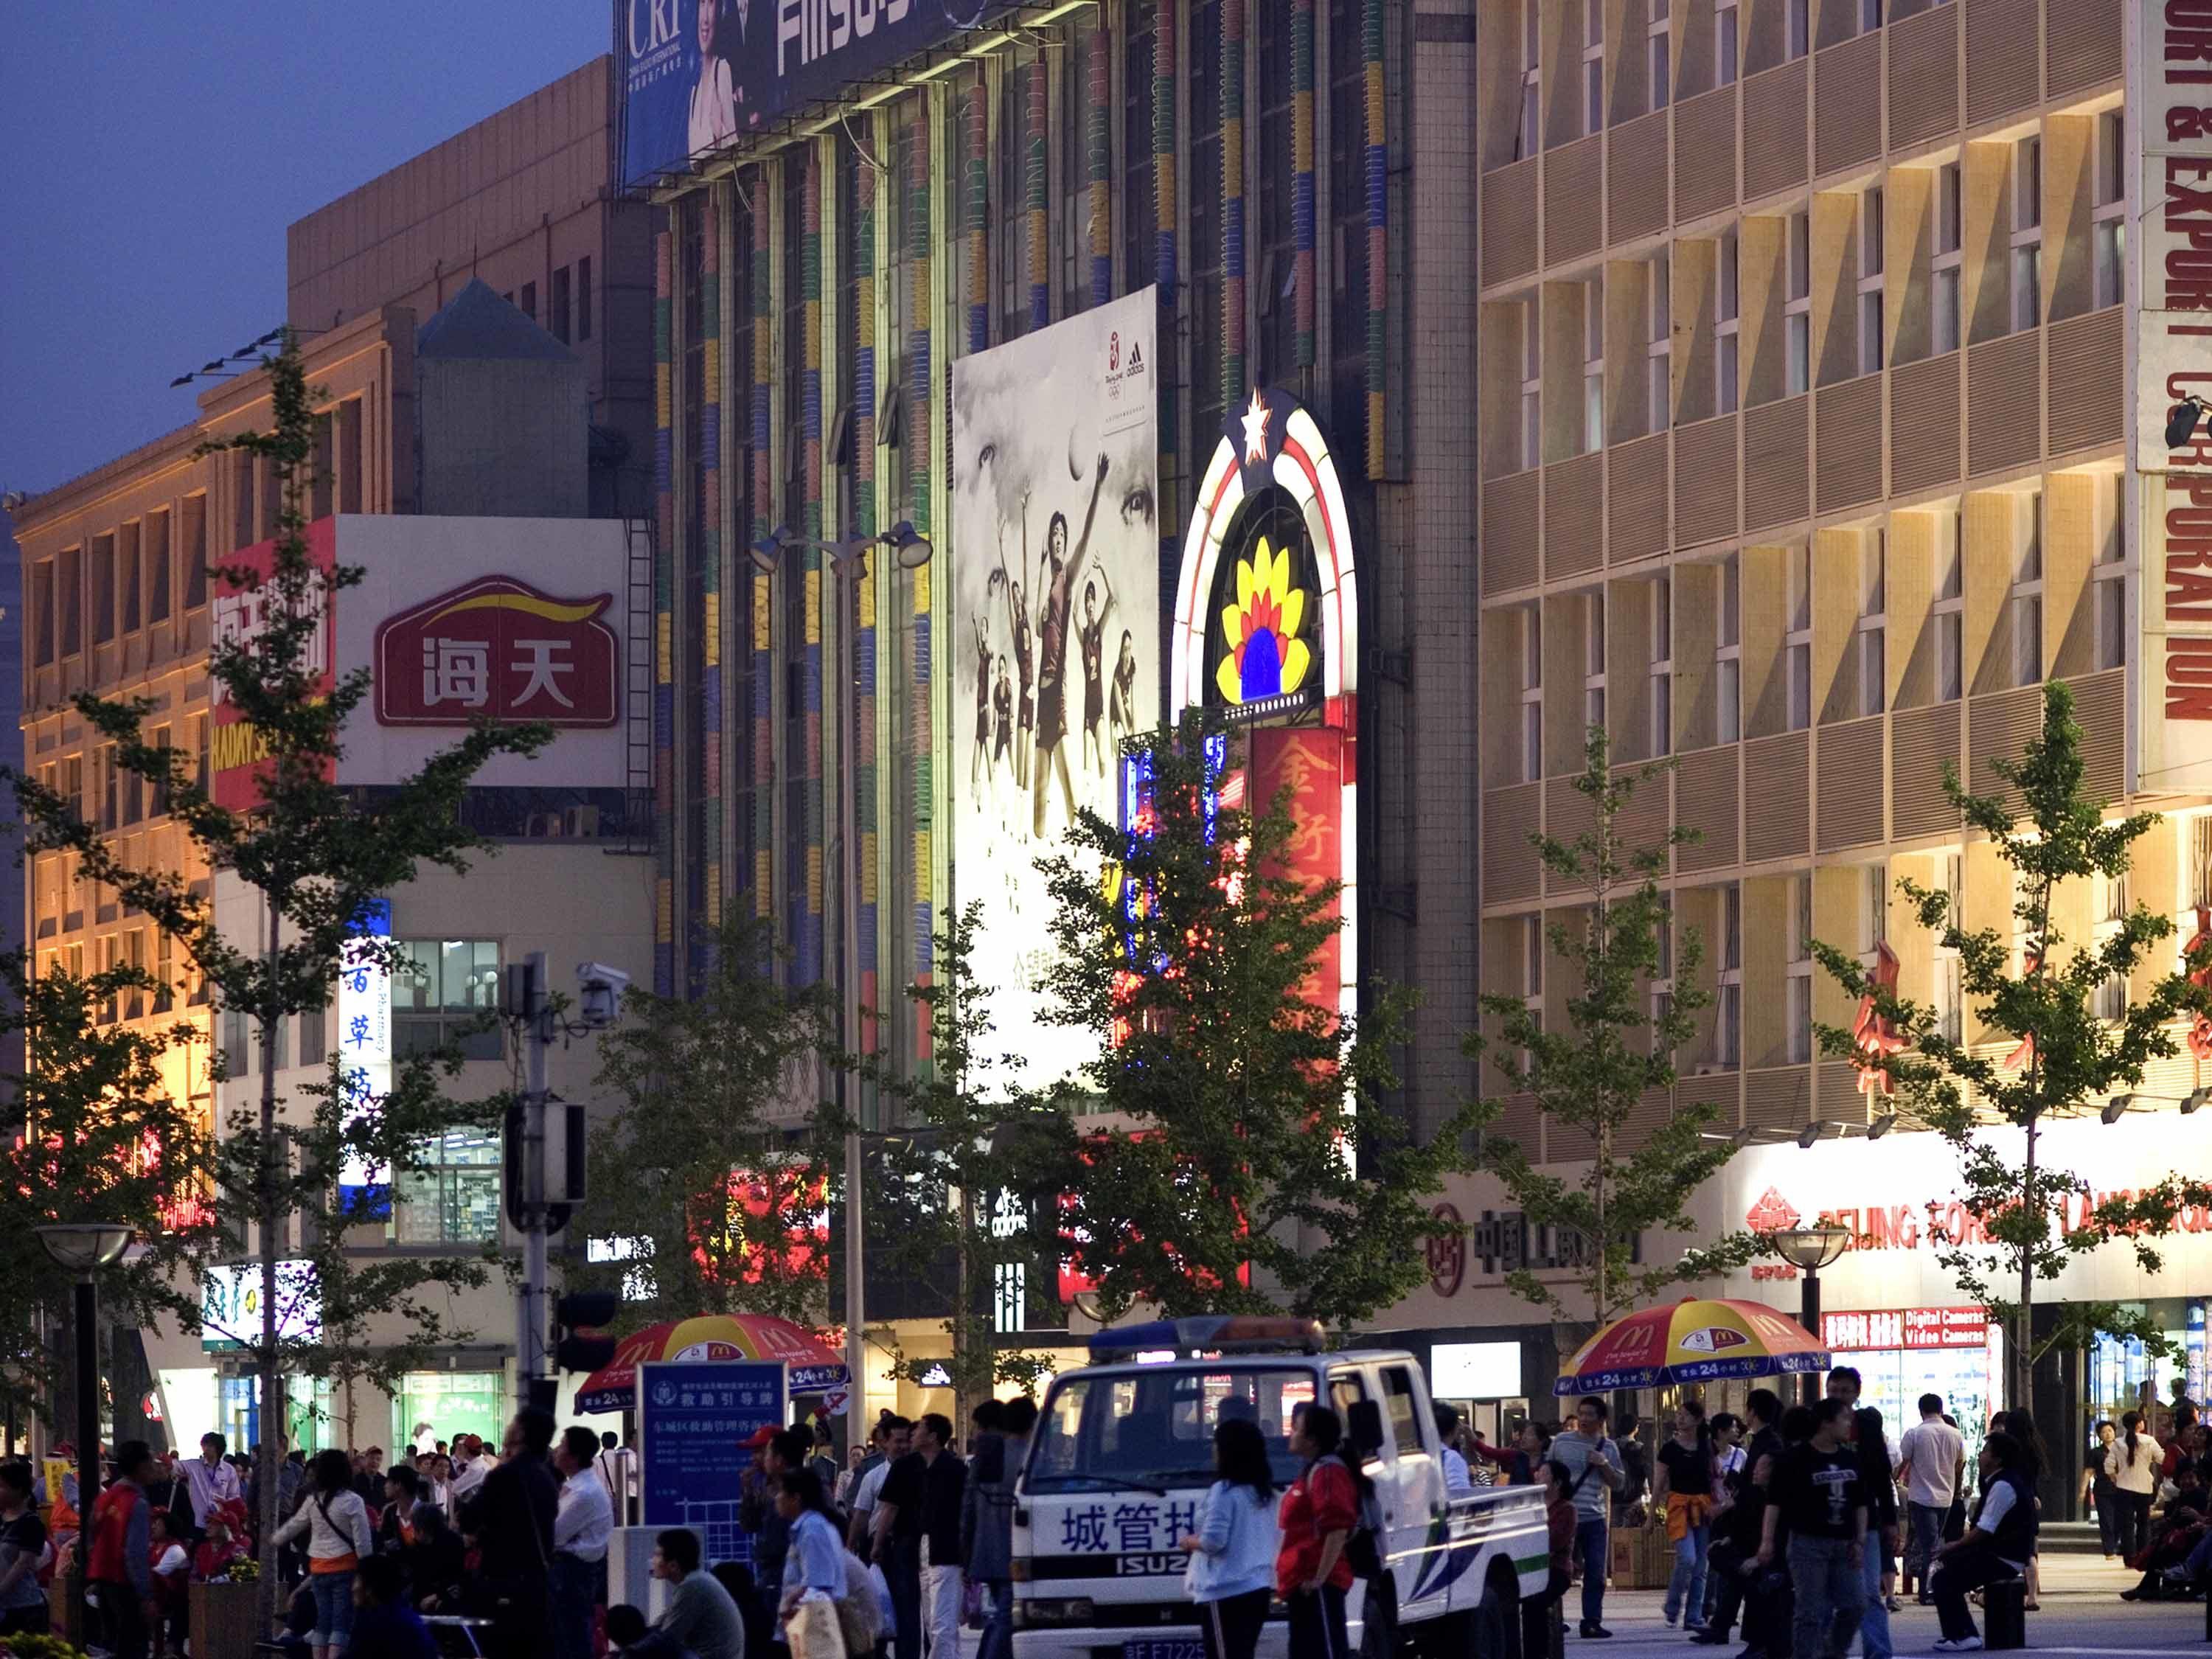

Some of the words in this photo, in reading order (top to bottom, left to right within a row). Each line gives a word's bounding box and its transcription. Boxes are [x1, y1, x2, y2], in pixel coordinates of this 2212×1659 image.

[1126, 363, 1145, 378] adidas
[423, 636, 575, 709] 海天
[1475, 1210, 1642, 1273] 中国工商
[1905, 1310, 1940, 1328] Digital
[1942, 1310, 1985, 1325] Cameras
[1905, 1329, 1939, 1344] Video
[1942, 1328, 1984, 1343] Cameras
[680, 1391, 773, 1408] 救助引导牌
